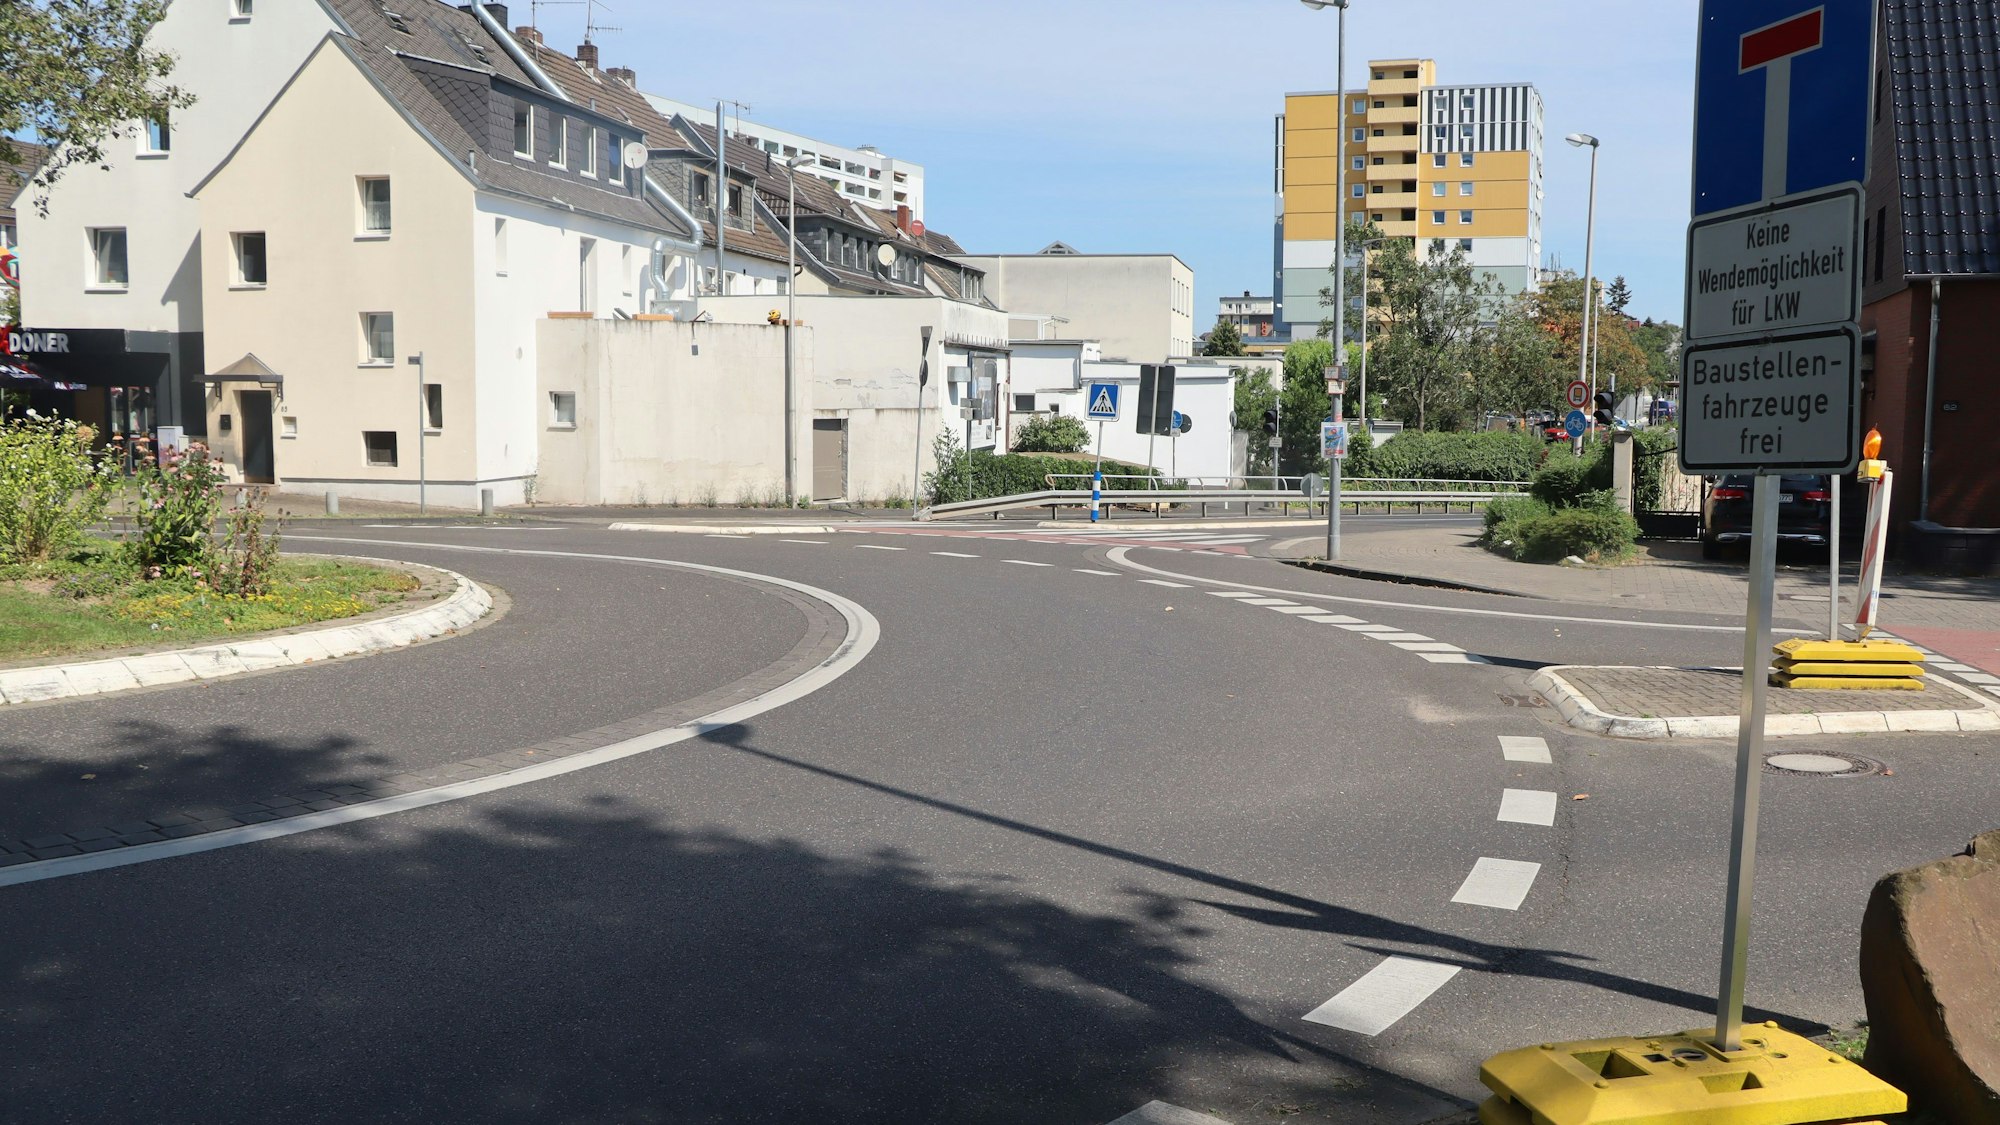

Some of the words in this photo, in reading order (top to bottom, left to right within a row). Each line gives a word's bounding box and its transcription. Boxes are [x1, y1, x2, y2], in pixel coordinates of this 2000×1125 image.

[1747, 220, 1790, 250] Keine
[1699, 246, 1844, 294] Wendemöglichkeit
[1732, 299, 1755, 326] für
[1764, 291, 1801, 322] LKW
[9, 327, 70, 353] DÖNER
[1693, 350, 1842, 385] Baustellen-
[1702, 392, 1829, 423] fahrzeuge
[1740, 426, 1782, 454] frei
